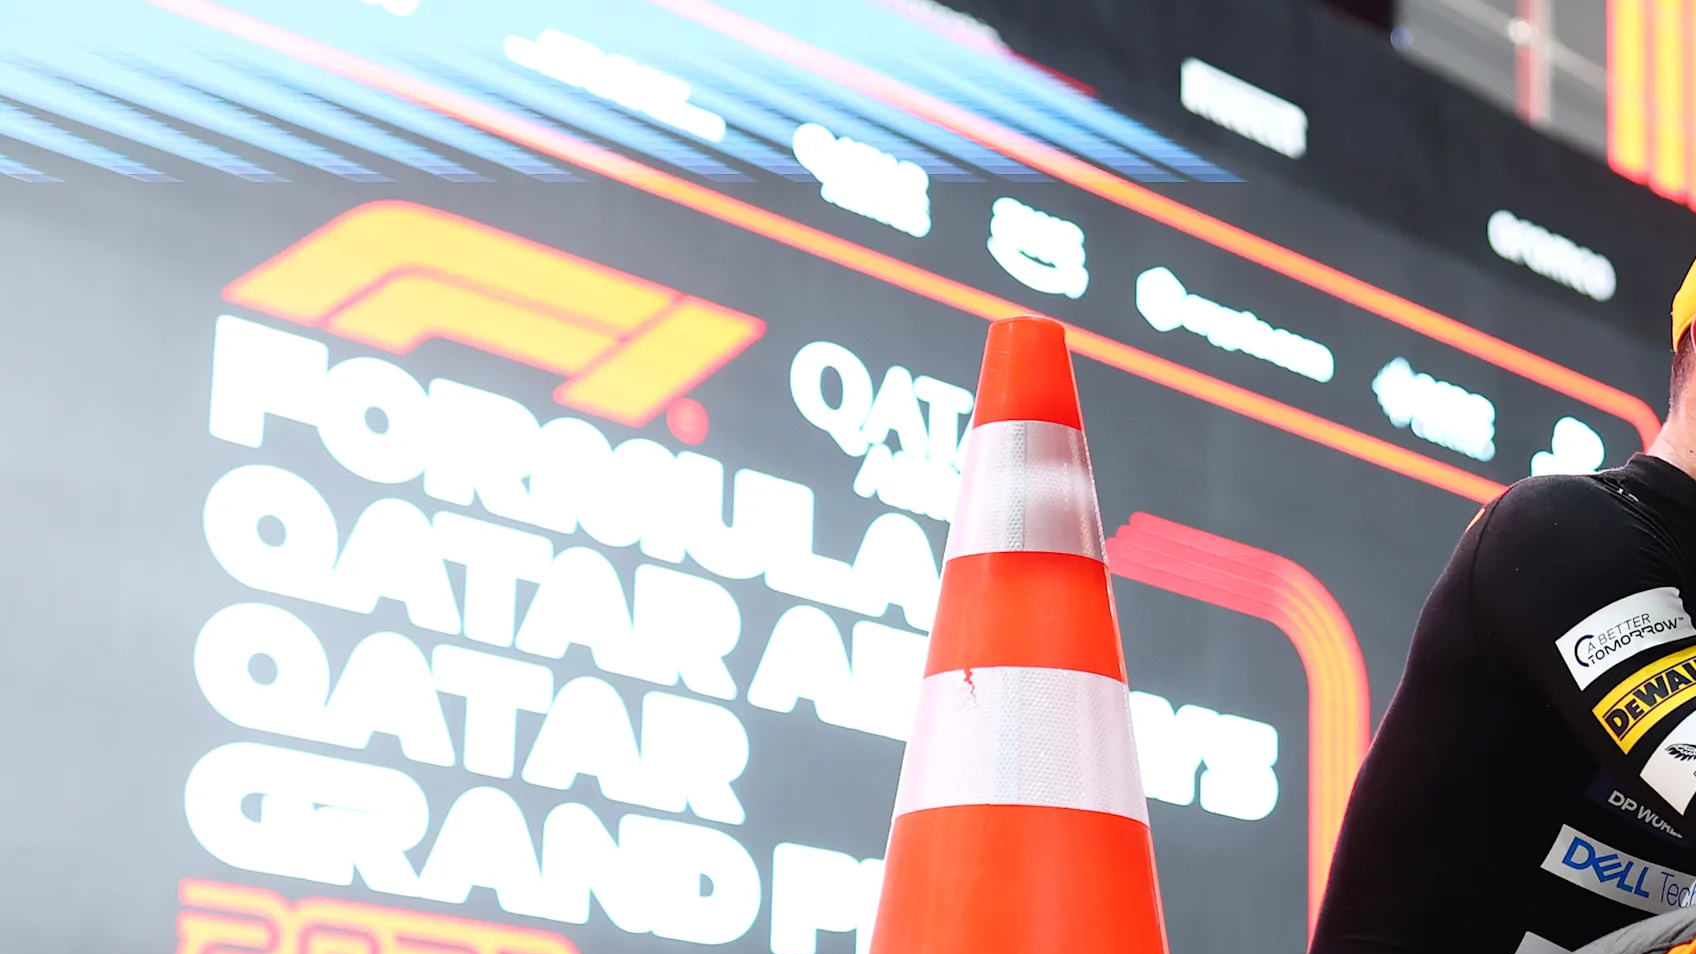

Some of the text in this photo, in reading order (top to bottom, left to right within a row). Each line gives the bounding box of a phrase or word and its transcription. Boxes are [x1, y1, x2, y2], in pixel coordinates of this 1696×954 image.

[208, 314, 942, 632] FORMULA
[790, 341, 974, 470] QAT
[203, 463, 741, 701] QATAR
[1598, 613, 1651, 645] BETTER
[193, 601, 750, 826] QATAR
[184, 741, 761, 946] GRAND
[1561, 836, 1650, 899] DELL
[1607, 790, 1638, 812] DP
